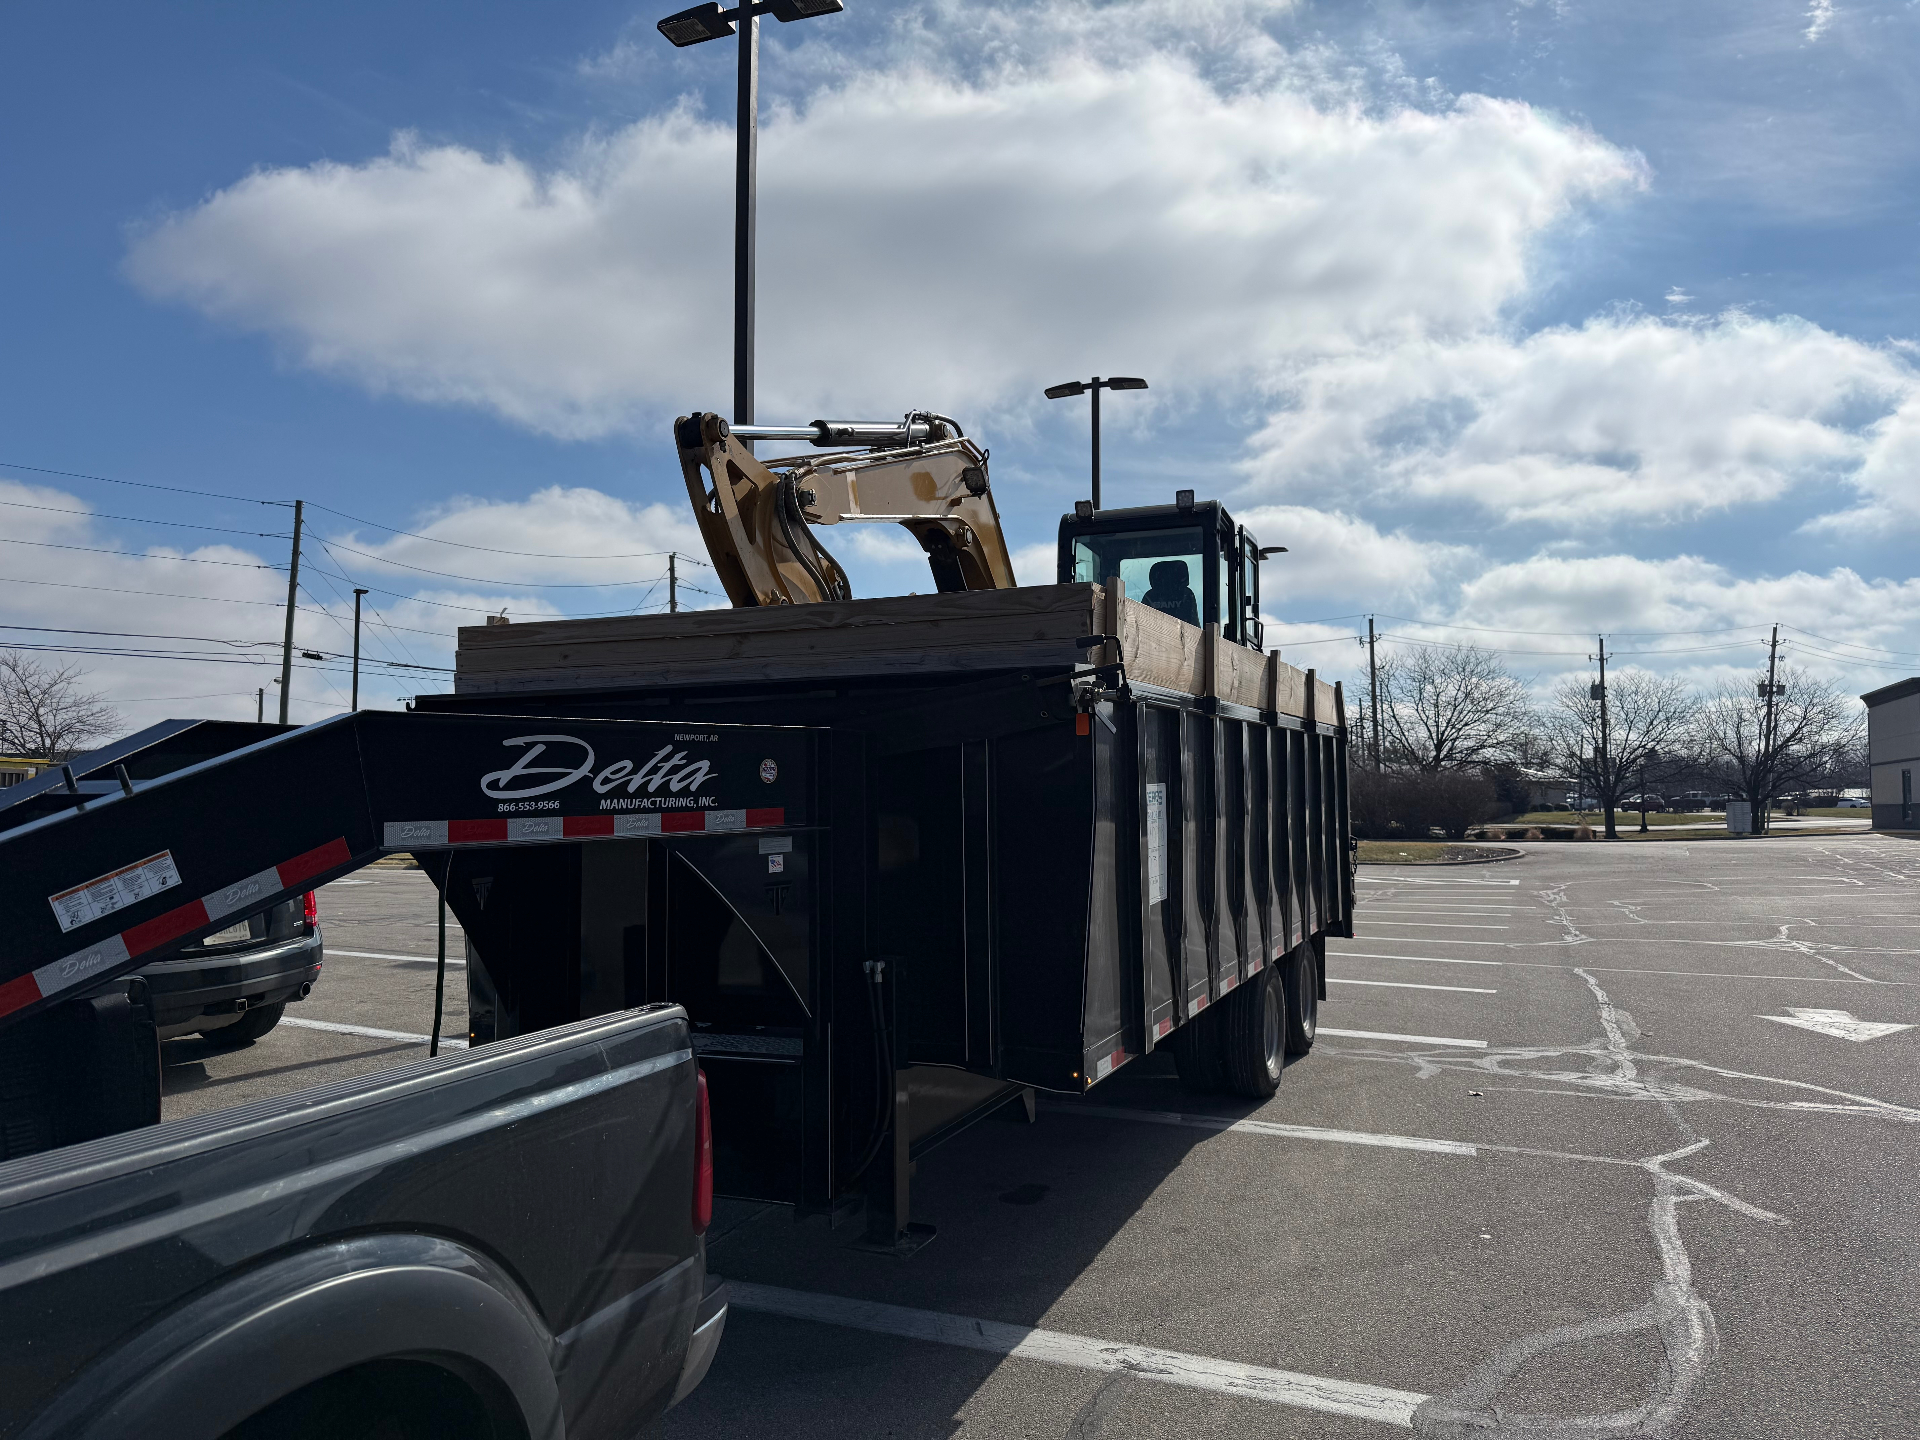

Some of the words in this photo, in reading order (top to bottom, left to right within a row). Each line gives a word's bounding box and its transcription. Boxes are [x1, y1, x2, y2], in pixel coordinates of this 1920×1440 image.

[1153, 601, 1182, 609] SANY
[674, 733, 709, 742] NEWPORT,
[710, 734, 719, 742] AR
[480, 734, 719, 799] Delta
[497, 800, 561, 813] 866-553-9566
[599, 797, 697, 810] MANUFACTURING,
[698, 796, 719, 808] INC.
[626, 818, 649, 828] Delta
[714, 813, 735, 824] Delta
[400, 826, 431, 838] Delta
[522, 822, 549, 833] Delta
[226, 880, 260, 905] Delta
[62, 953, 101, 978] Delta
